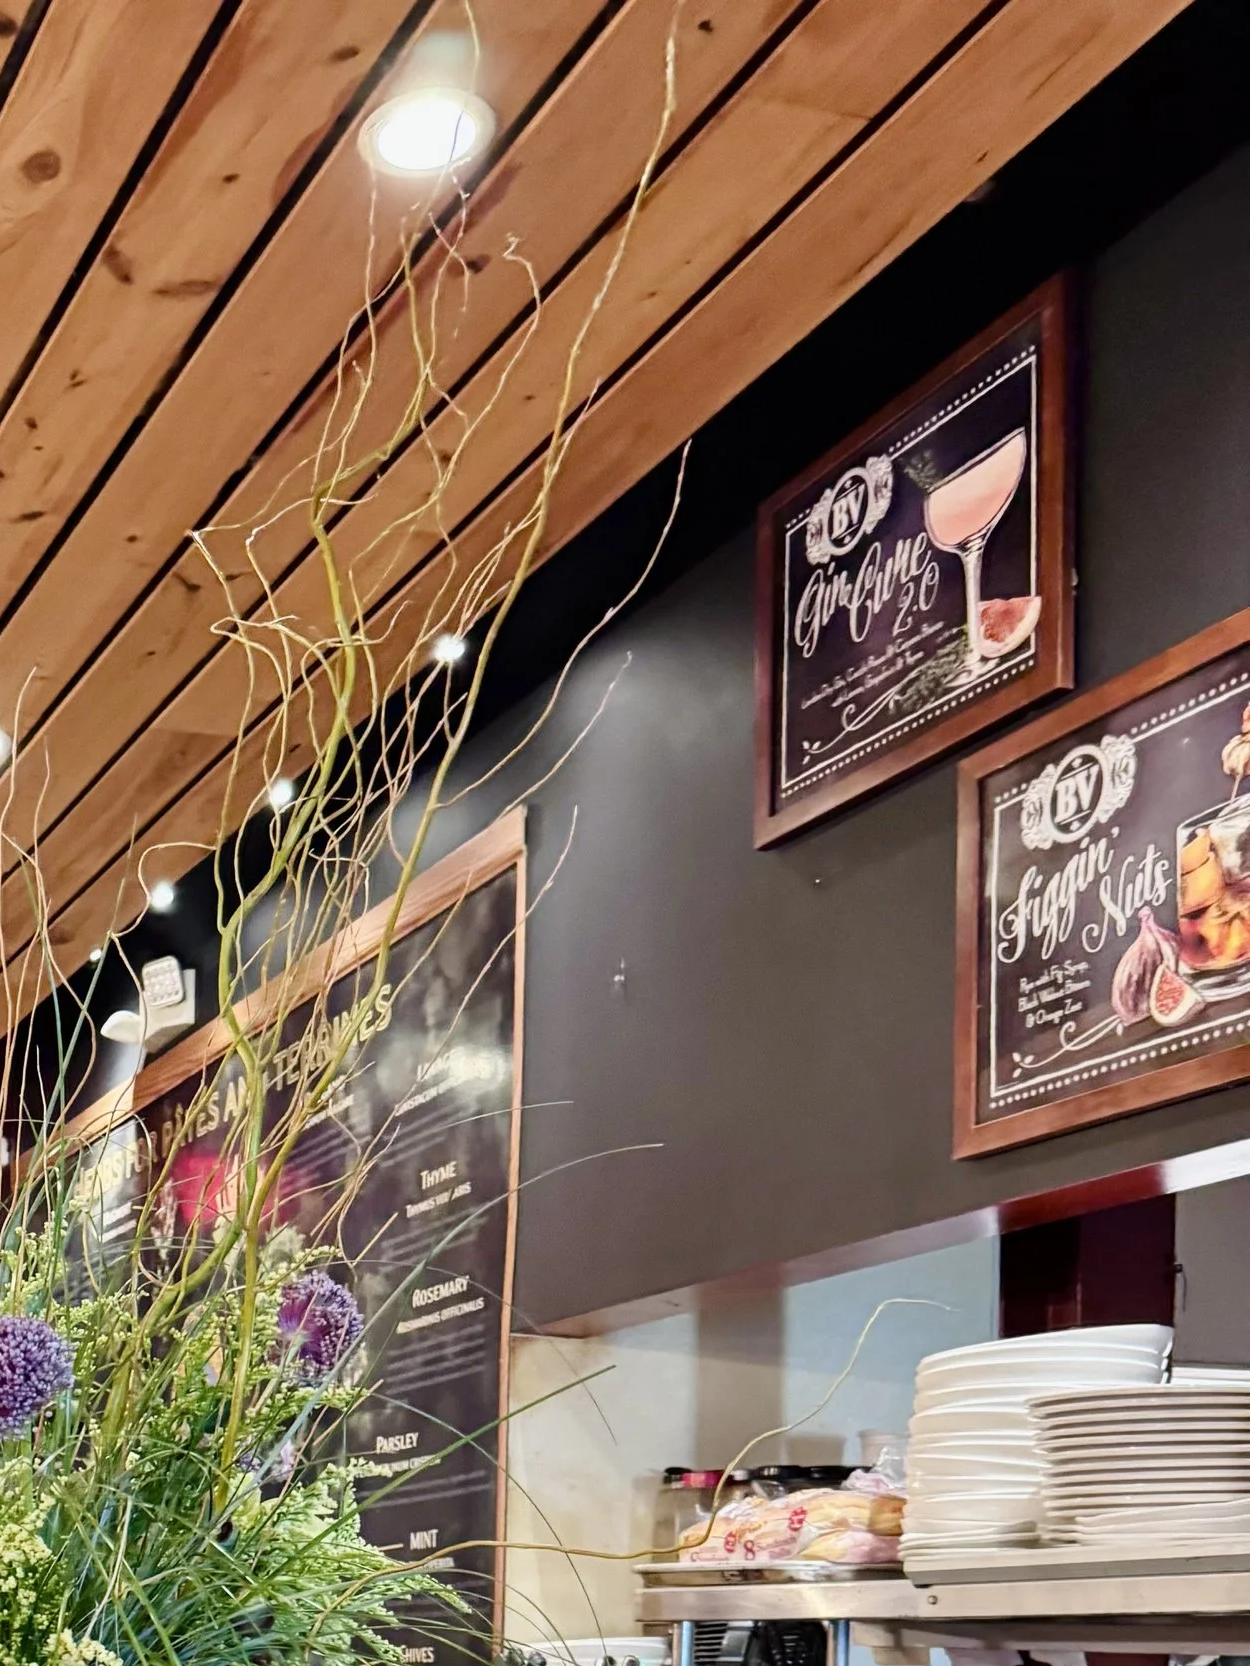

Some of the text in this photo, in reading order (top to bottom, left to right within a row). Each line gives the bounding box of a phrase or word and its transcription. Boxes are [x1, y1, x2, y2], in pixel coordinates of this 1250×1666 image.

[831, 483, 866, 540] BV
[893, 562, 940, 636] 2.0
[1055, 764, 1100, 823] BV
[1082, 843, 1174, 953] Nuts
[419, 1160, 457, 1190] THYME
[411, 1275, 470, 1309] ROSEMARY
[376, 1432, 419, 1454] PARSLEY
[410, 1529, 439, 1550] MINT
